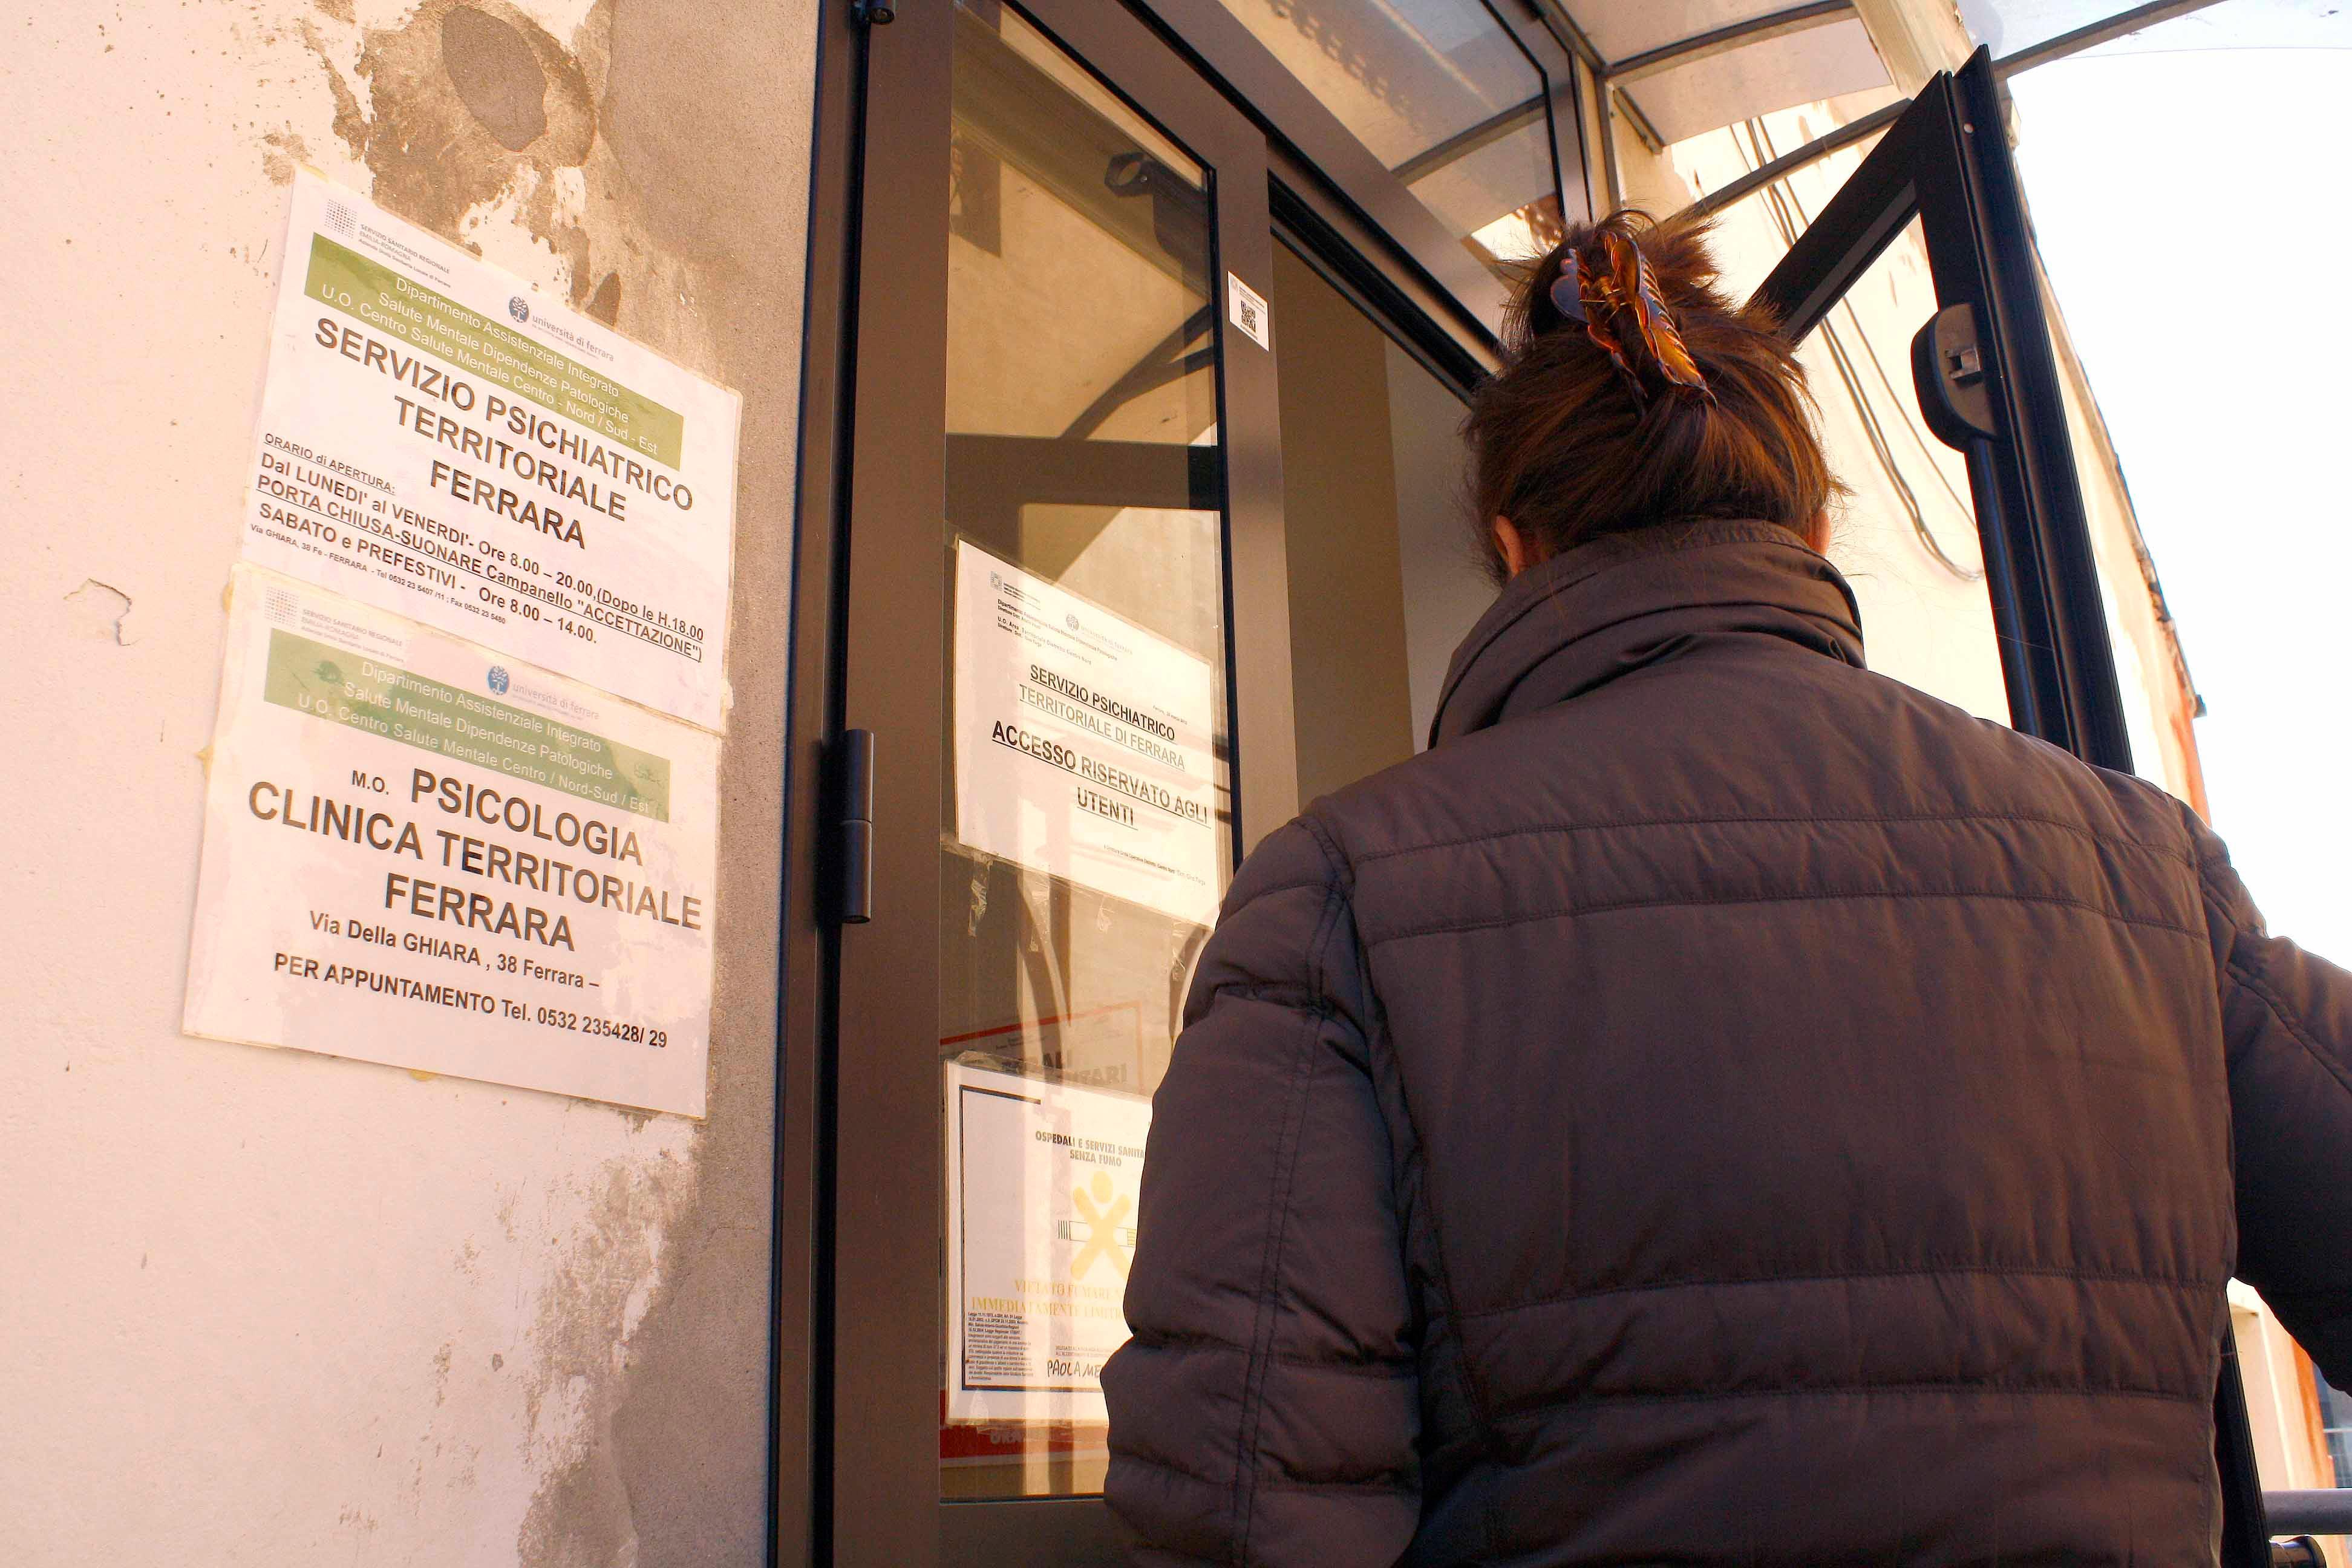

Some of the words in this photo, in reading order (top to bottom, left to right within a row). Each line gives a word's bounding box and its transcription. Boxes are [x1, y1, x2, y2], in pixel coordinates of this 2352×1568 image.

[322, 283, 354, 310] U.O.
[359, 302, 407, 334] Centro
[410, 326, 453, 357] Salute
[457, 347, 509, 383] Mentale
[513, 375, 554, 404] Centro
[566, 400, 595, 423] Nord
[604, 419, 628, 440] Sud
[638, 435, 657, 455] Est
[377, 292, 423, 323] Salute
[426, 313, 479, 350] Mentale
[483, 342, 557, 388] Dipendenze
[560, 379, 629, 423] Patologiche
[396, 276, 481, 328] Dipartimento
[482, 321, 564, 370] Assistenziale
[567, 362, 619, 397] Integrato
[532, 315, 574, 341] università
[575, 336, 584, 347] di
[586, 340, 613, 362] ferrara
[265, 433, 313, 459] ORARIO
[316, 454, 327, 465] di
[328, 459, 394, 493] APERTURA:
[314, 318, 475, 411] SERVIZIO
[485, 394, 693, 511] PSICHIATRICO
[394, 394, 626, 521] TERRITORIALE
[261, 452, 290, 476] Dal
[296, 466, 367, 505] LUNEDI'
[371, 500, 386, 514] al
[479, 540, 505, 561] Ore
[510, 552, 539, 575] 8.00
[642, 604, 653, 620] le
[658, 611, 704, 641] H.18.00
[430, 459, 585, 550] FERRARA
[257, 474, 321, 511] PORTA
[327, 501, 482, 574] CHIUSA-SUONARE
[486, 564, 572, 609] Campanello
[577, 599, 702, 661] "ACCETTAZIONE")
[259, 502, 336, 543] SABATO
[341, 537, 351, 549] e
[357, 538, 456, 589] PREFESTIVI
[479, 586, 505, 608] Ore
[509, 598, 540, 621] 8.00
[557, 616, 596, 644] 14.00.
[344, 681, 391, 708] Salute
[396, 697, 452, 728] Mentale
[456, 717, 536, 755] Dipendenze
[540, 744, 613, 779] Patologiche
[361, 661, 452, 703] Dipartimento
[455, 693, 543, 733] Assistenziale
[546, 722, 601, 752] Integrato
[1018, 683, 1111, 737] TERRITORIALE
[1115, 726, 1126, 744] DI
[1130, 733, 1185, 770] FERRARA
[1030, 664, 1088, 702] SERVIZIO
[1092, 693, 1175, 741] PSICHIATRICO
[298, 693, 332, 716] U.O.
[338, 705, 388, 733] Centro
[393, 722, 439, 748] Salute
[443, 738, 497, 766] Mentale
[502, 757, 546, 782] Centro
[629, 796, 649, 812] Est
[991, 720, 1076, 770] ACCESSO
[1081, 755, 1170, 808] RISERVATO
[1174, 795, 1207, 825] AGLI
[351, 769, 389, 795] M.O.
[411, 768, 642, 866] PSICOLOGIA
[1077, 786, 1134, 826] UTENTI
[248, 781, 423, 860] CLINICA
[436, 829, 701, 930] TERRITORIALE
[310, 910, 340, 935] Via
[347, 919, 396, 947] Della
[403, 932, 480, 965] GHIARA
[497, 953, 517, 973] 38
[523, 958, 584, 988] Ferrara
[385, 872, 575, 952] FERRARA
[274, 952, 319, 979] PER
[323, 964, 495, 1014] APPUNTAMENTO
[501, 998, 531, 1022] Tel.
[537, 1007, 577, 1030] 0532
[648, 1029, 667, 1048] 29
[1069, 1149, 1096, 1163] SENZA
[1099, 1154, 1122, 1167] FUMO
[1117, 1145, 1145, 1160] SANITA
[1047, 1359, 1081, 1378] PAOLA
[1083, 1364, 1102, 1379] ME
